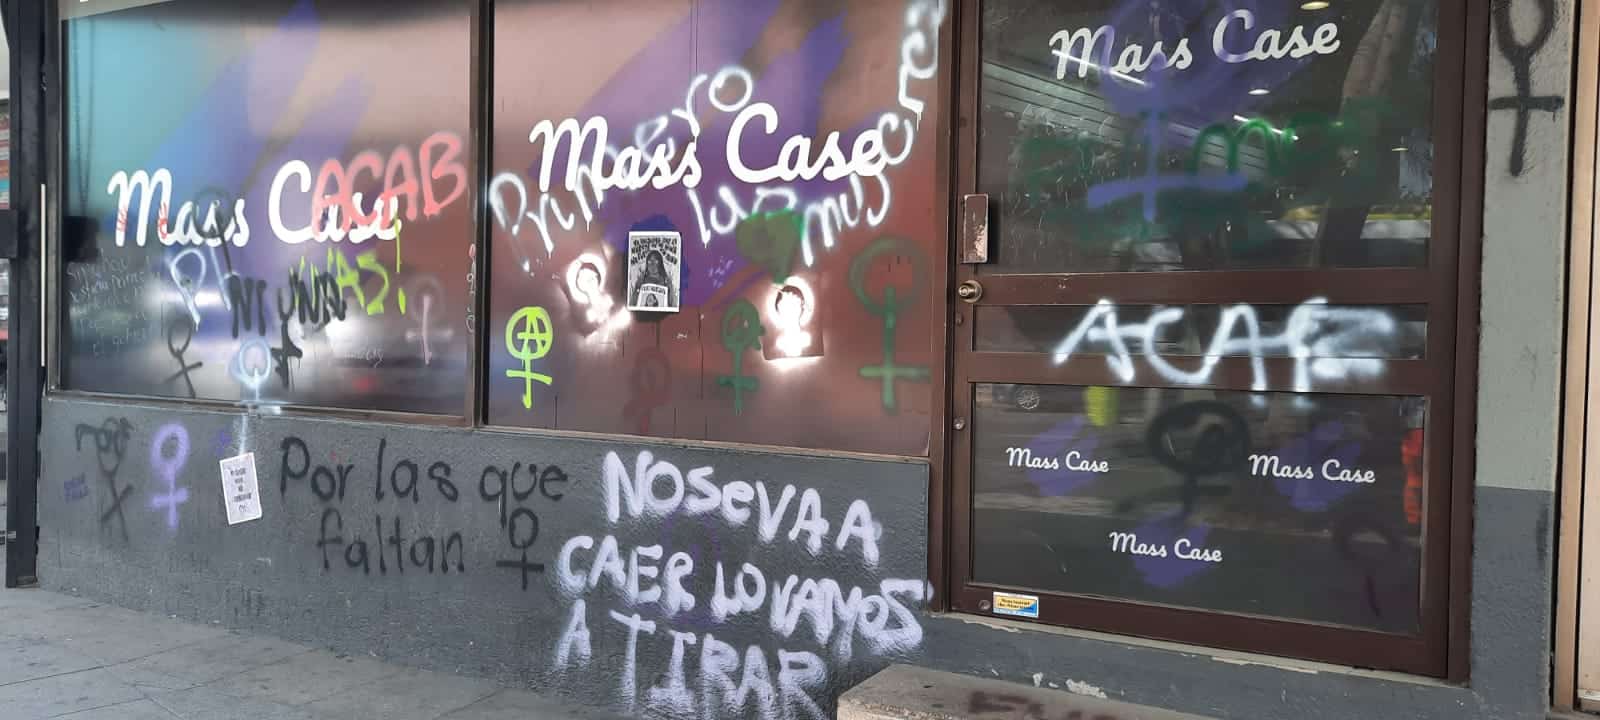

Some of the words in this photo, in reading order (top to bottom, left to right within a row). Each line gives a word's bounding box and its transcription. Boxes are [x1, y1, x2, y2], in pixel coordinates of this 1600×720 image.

[1050, 24, 1193, 80] Mass
[1212, 9, 1341, 64] Case
[312, 132, 467, 242] ACAB
[530, 116, 702, 192] Mass
[727, 103, 887, 184] Case
[107, 167, 251, 247] Mass
[280, 437, 355, 500] Por
[375, 437, 459, 503] las
[479, 459, 569, 528] que
[1006, 447, 1059, 470] Mass
[1065, 450, 1110, 473] Case
[1248, 454, 1314, 480] Mass
[1321, 458, 1376, 484] Case
[316, 507, 465, 576] faltan
[556, 534, 696, 620] CAER
[1109, 531, 1168, 558] Mass
[1174, 538, 1223, 563] Case
[608, 606, 830, 720] TIRAR
